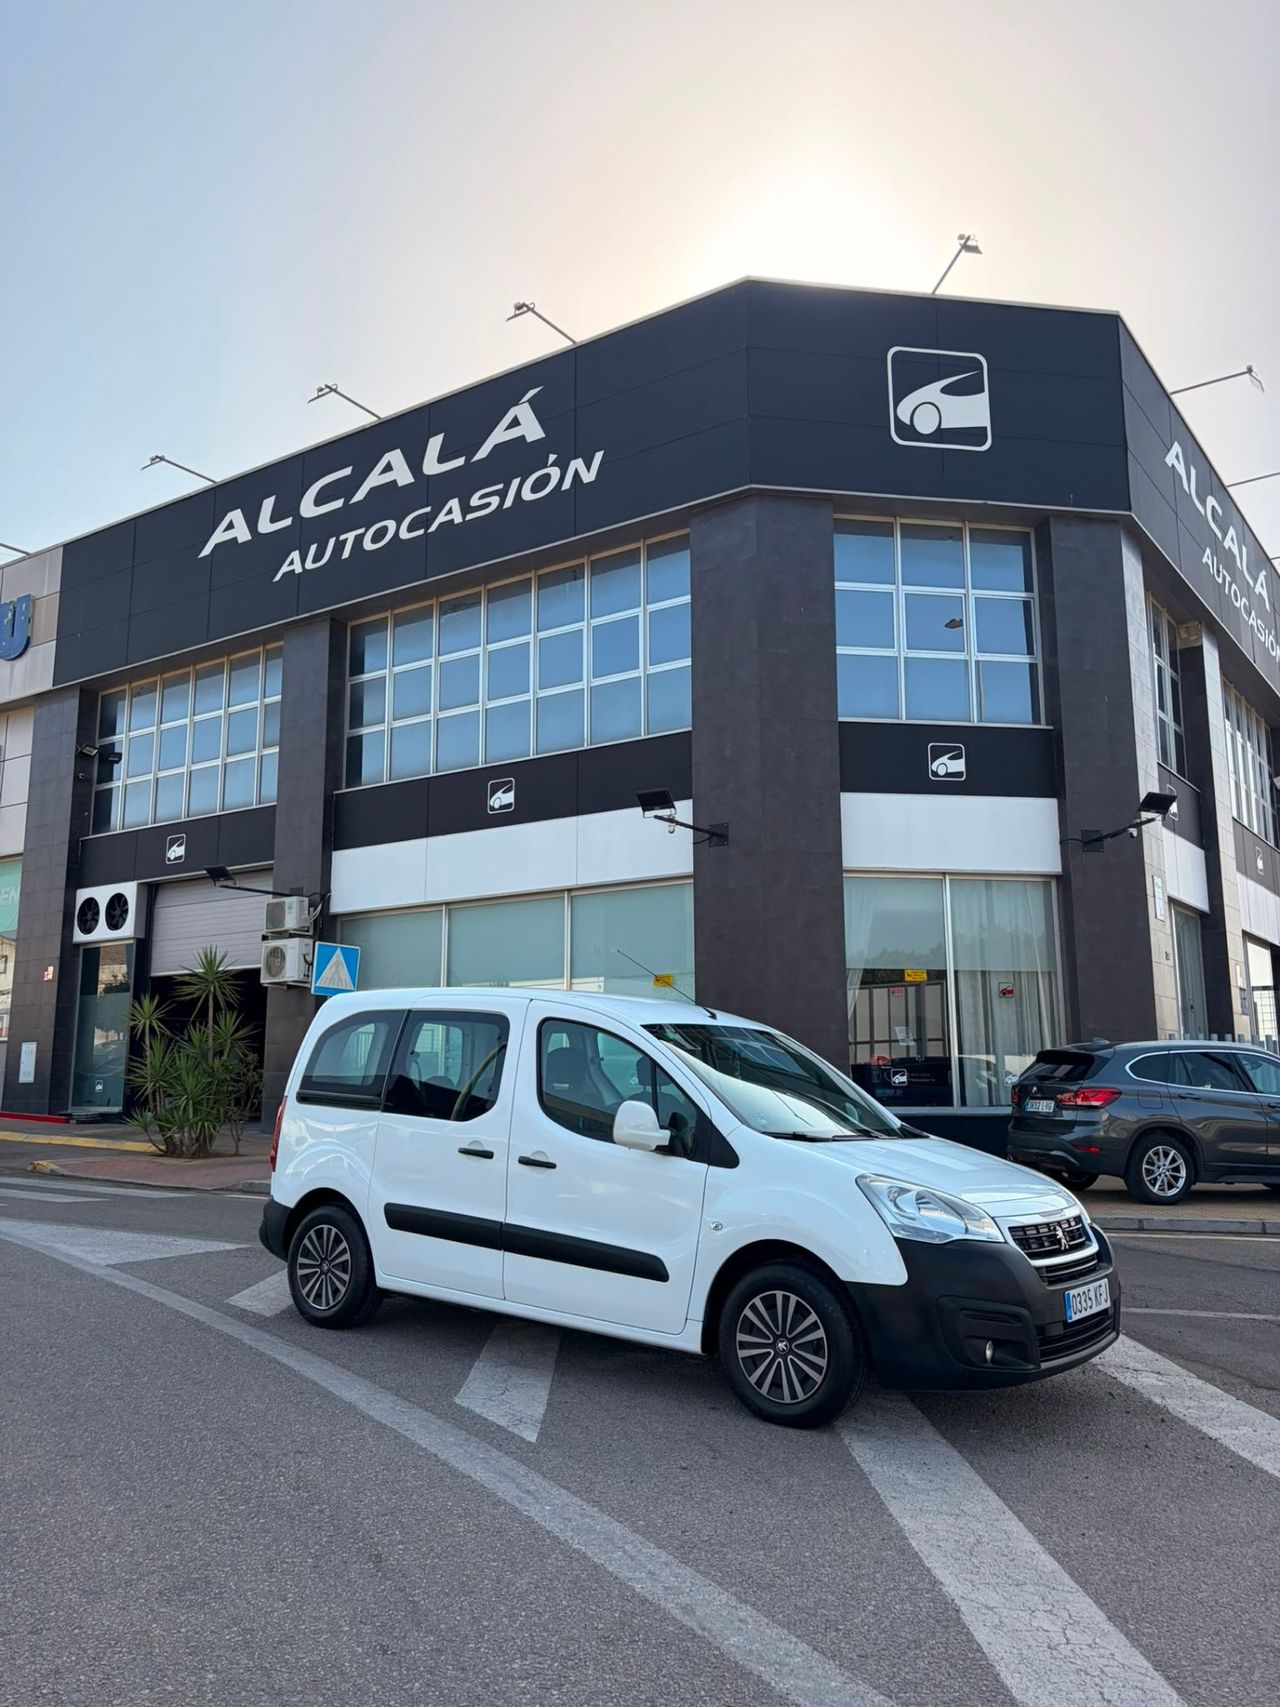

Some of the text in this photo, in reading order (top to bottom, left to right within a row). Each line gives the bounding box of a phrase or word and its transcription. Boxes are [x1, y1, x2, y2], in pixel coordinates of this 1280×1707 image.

[197, 385, 546, 559] ALCALÁ
[272, 450, 605, 583] AUTOCASIÓN
[1164, 440, 1271, 613] ALCALÁ
[1071, 1282, 1109, 1316] 0335 KFJ
